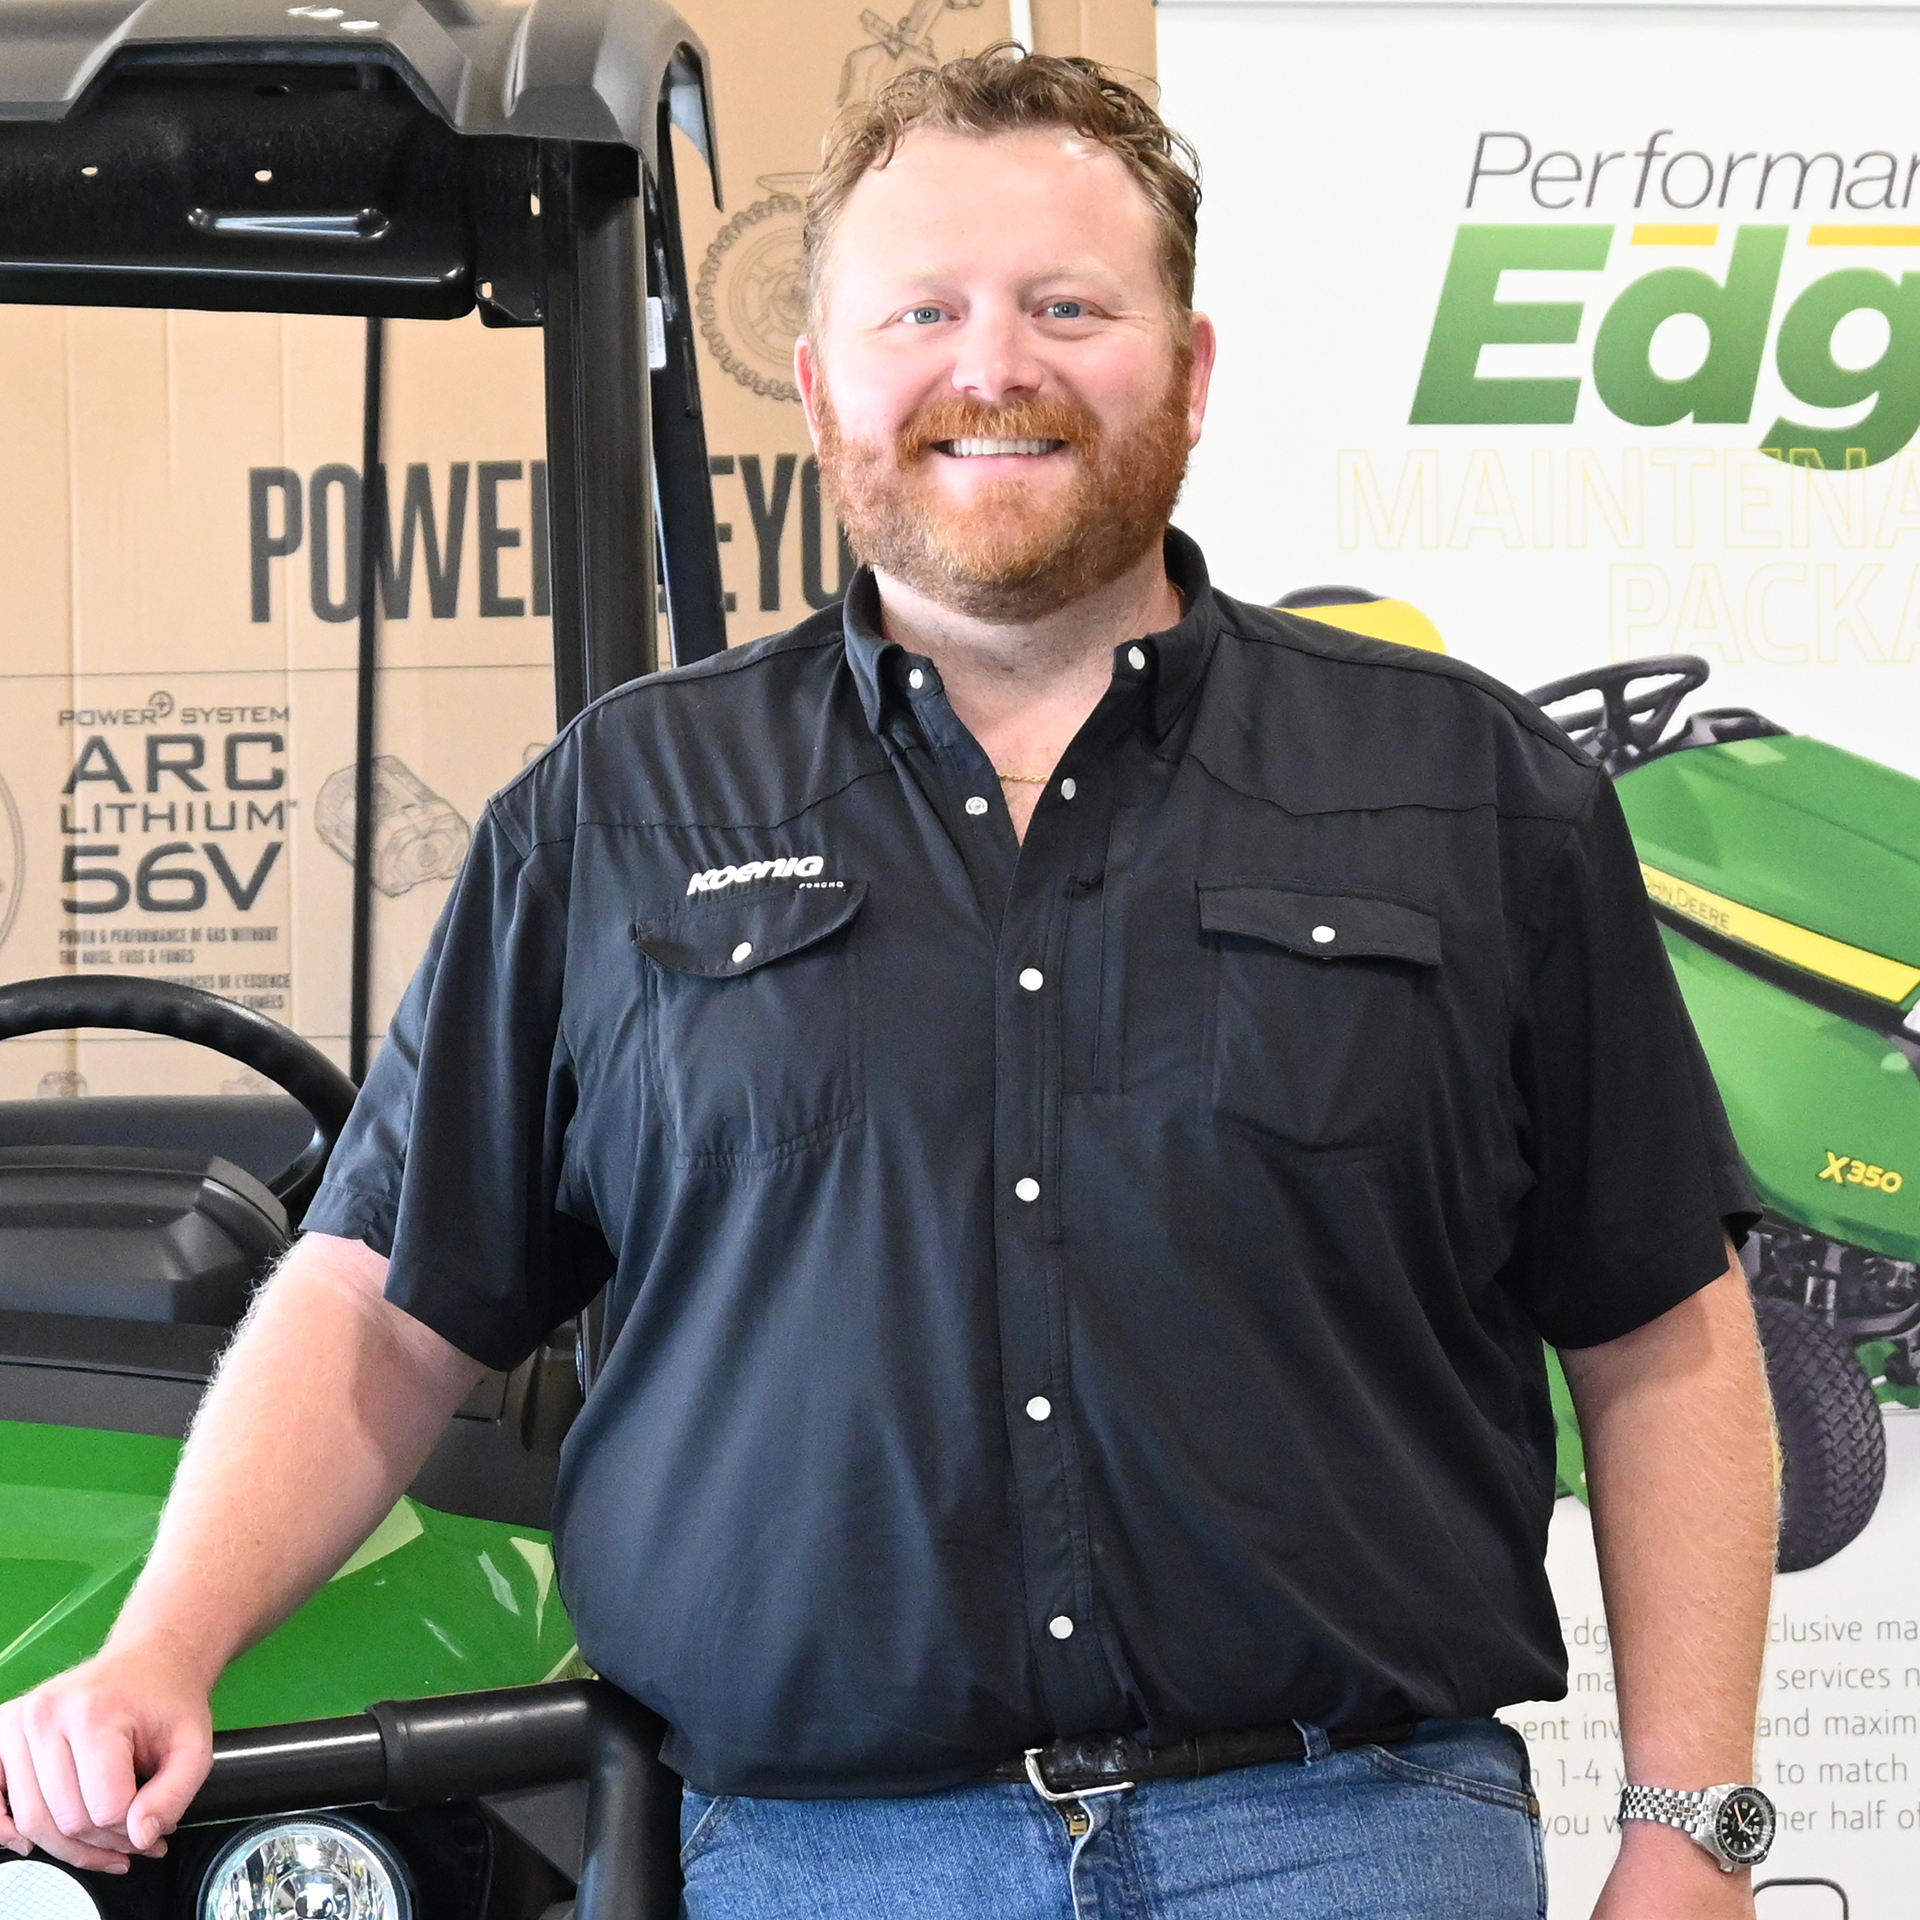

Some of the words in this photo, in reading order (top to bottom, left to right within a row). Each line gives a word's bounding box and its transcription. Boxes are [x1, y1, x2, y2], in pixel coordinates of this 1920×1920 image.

[58, 708, 157, 726] POWER
[181, 706, 290, 724] SYSTEM
[61, 732, 284, 794] ARC
[61, 841, 284, 914] 56V
[1676, 887, 1730, 930] DEERE
[1817, 1150, 1904, 1194] X350
[1776, 1662, 1891, 1690] services
[1758, 1707, 1810, 1737] and
[1556, 1759, 1601, 1788] 1-4
[1776, 1760, 1805, 1785] to
[1819, 1753, 1908, 1784] match
[1831, 1799, 1886, 1831] half
